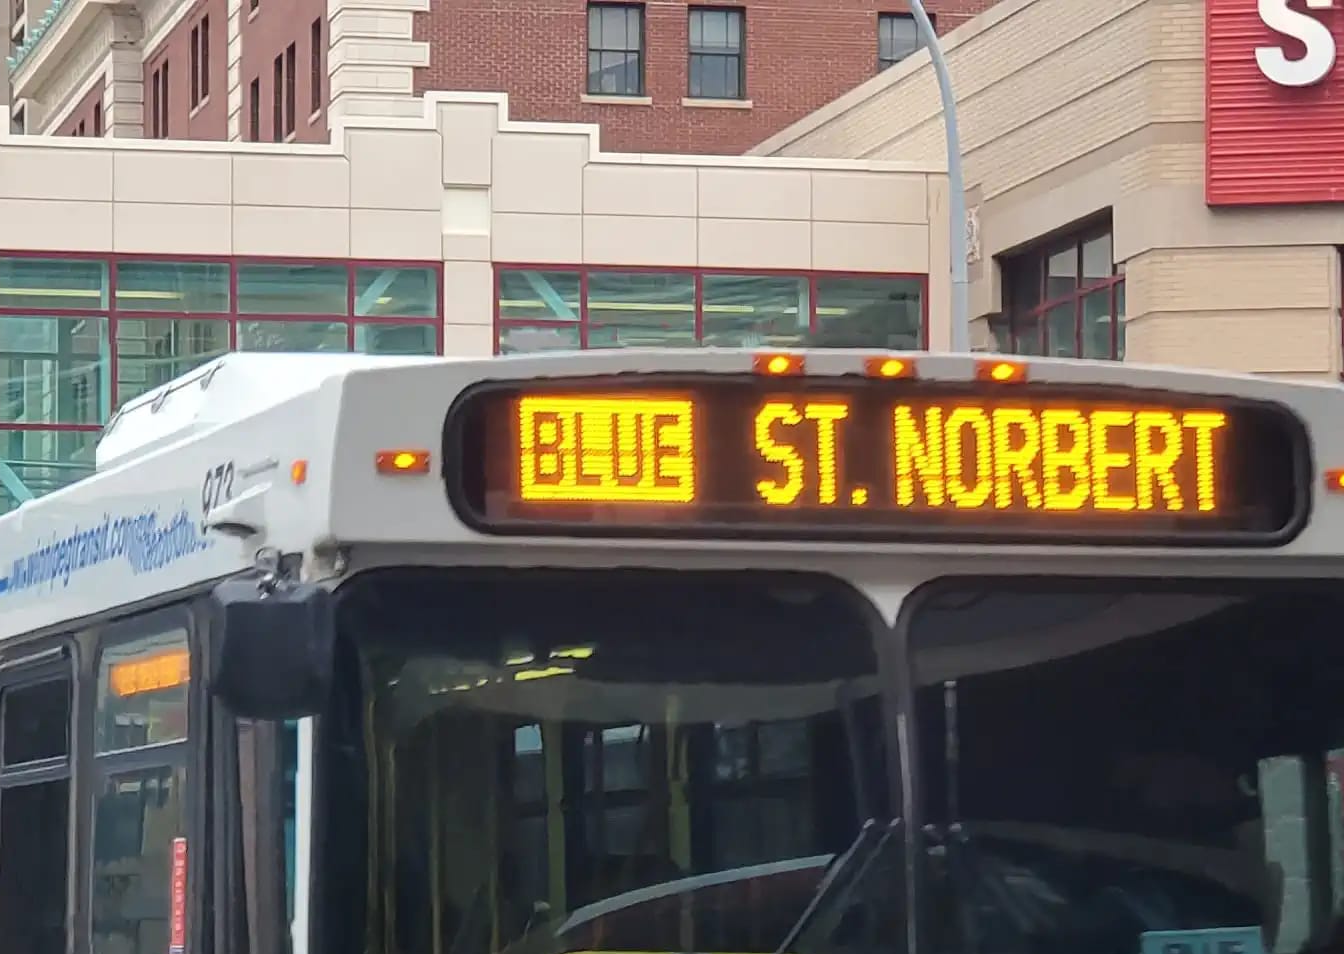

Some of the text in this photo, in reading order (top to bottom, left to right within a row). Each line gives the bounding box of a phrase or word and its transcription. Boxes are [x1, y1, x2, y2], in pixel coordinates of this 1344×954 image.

[524, 402, 1227, 511] BLUE ST. NORBERT
